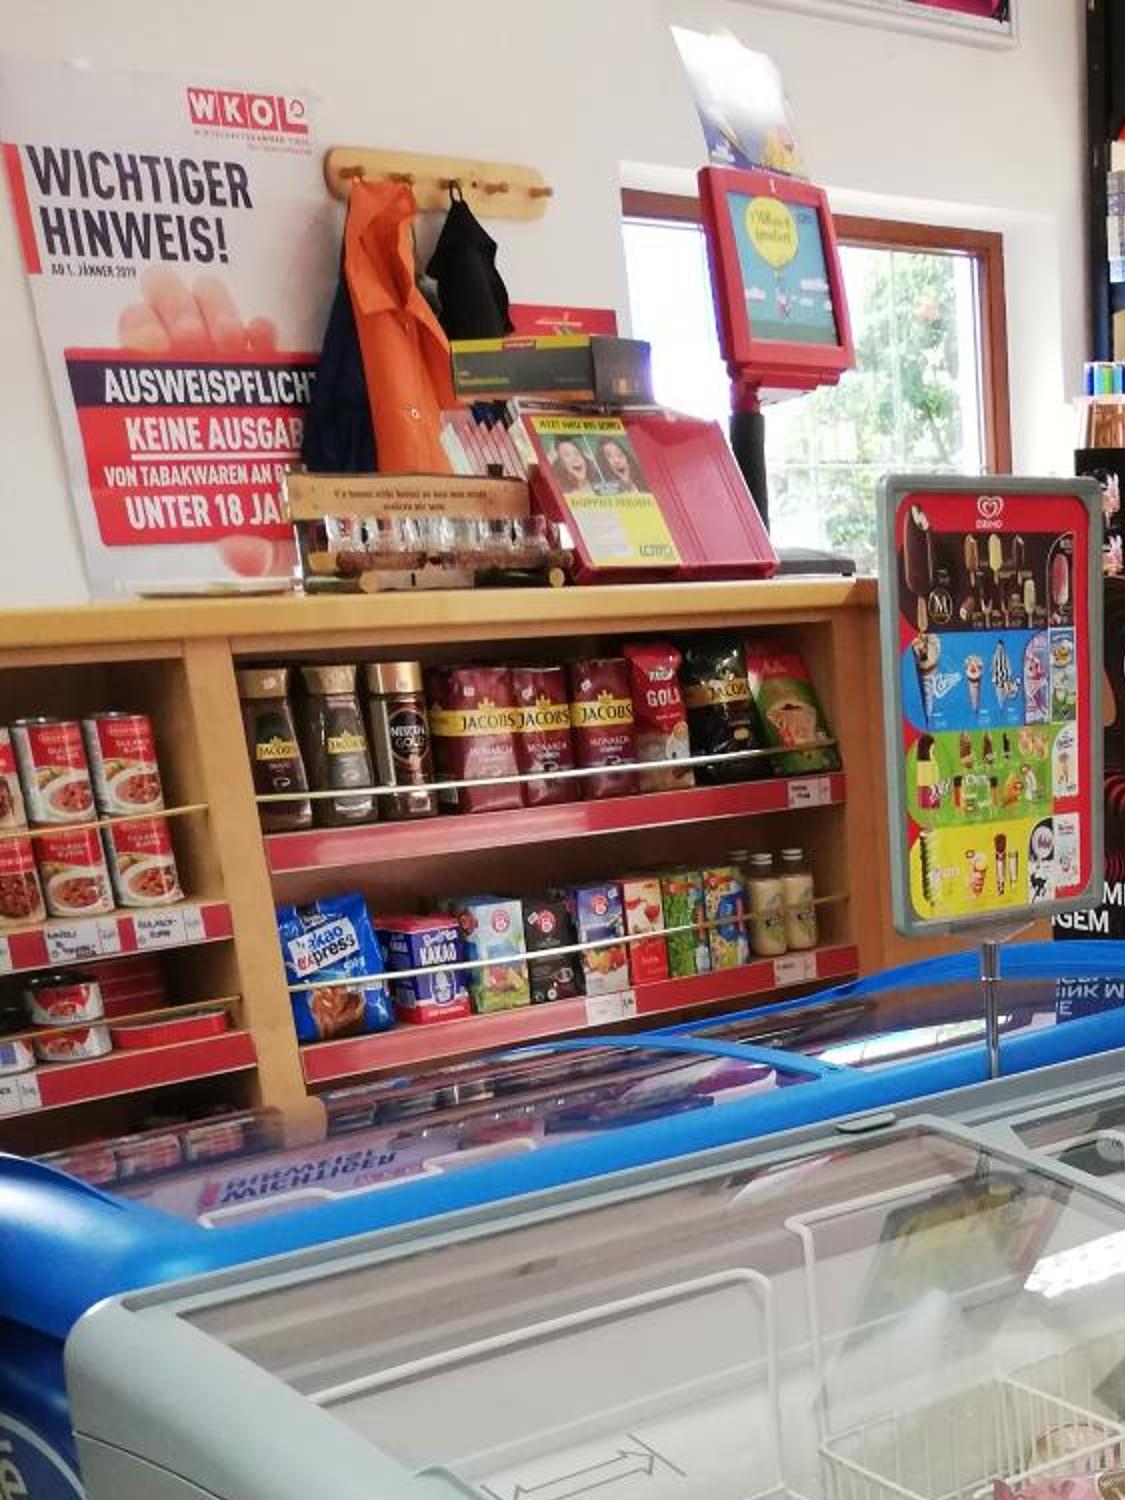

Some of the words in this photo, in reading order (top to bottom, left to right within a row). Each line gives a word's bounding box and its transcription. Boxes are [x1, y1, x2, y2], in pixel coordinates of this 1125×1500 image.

[26, 145, 253, 209] WICHTIGER
[40, 207, 229, 264] HINWEIS!
[105, 368, 316, 404] AUSWEISPFLICH
[125, 417, 200, 451] KEINE
[209, 417, 304, 450] AUSGAB
[104, 466, 138, 487] VON
[140, 465, 248, 487] TABAKWAREN
[251, 464, 272, 485] AN
[125, 494, 211, 530] UNTER
[215, 493, 244, 527] 18
[461, 713, 514, 731] JACOBS
[518, 710, 569, 728] JACOBS
[581, 704, 632, 721] JACOBS
